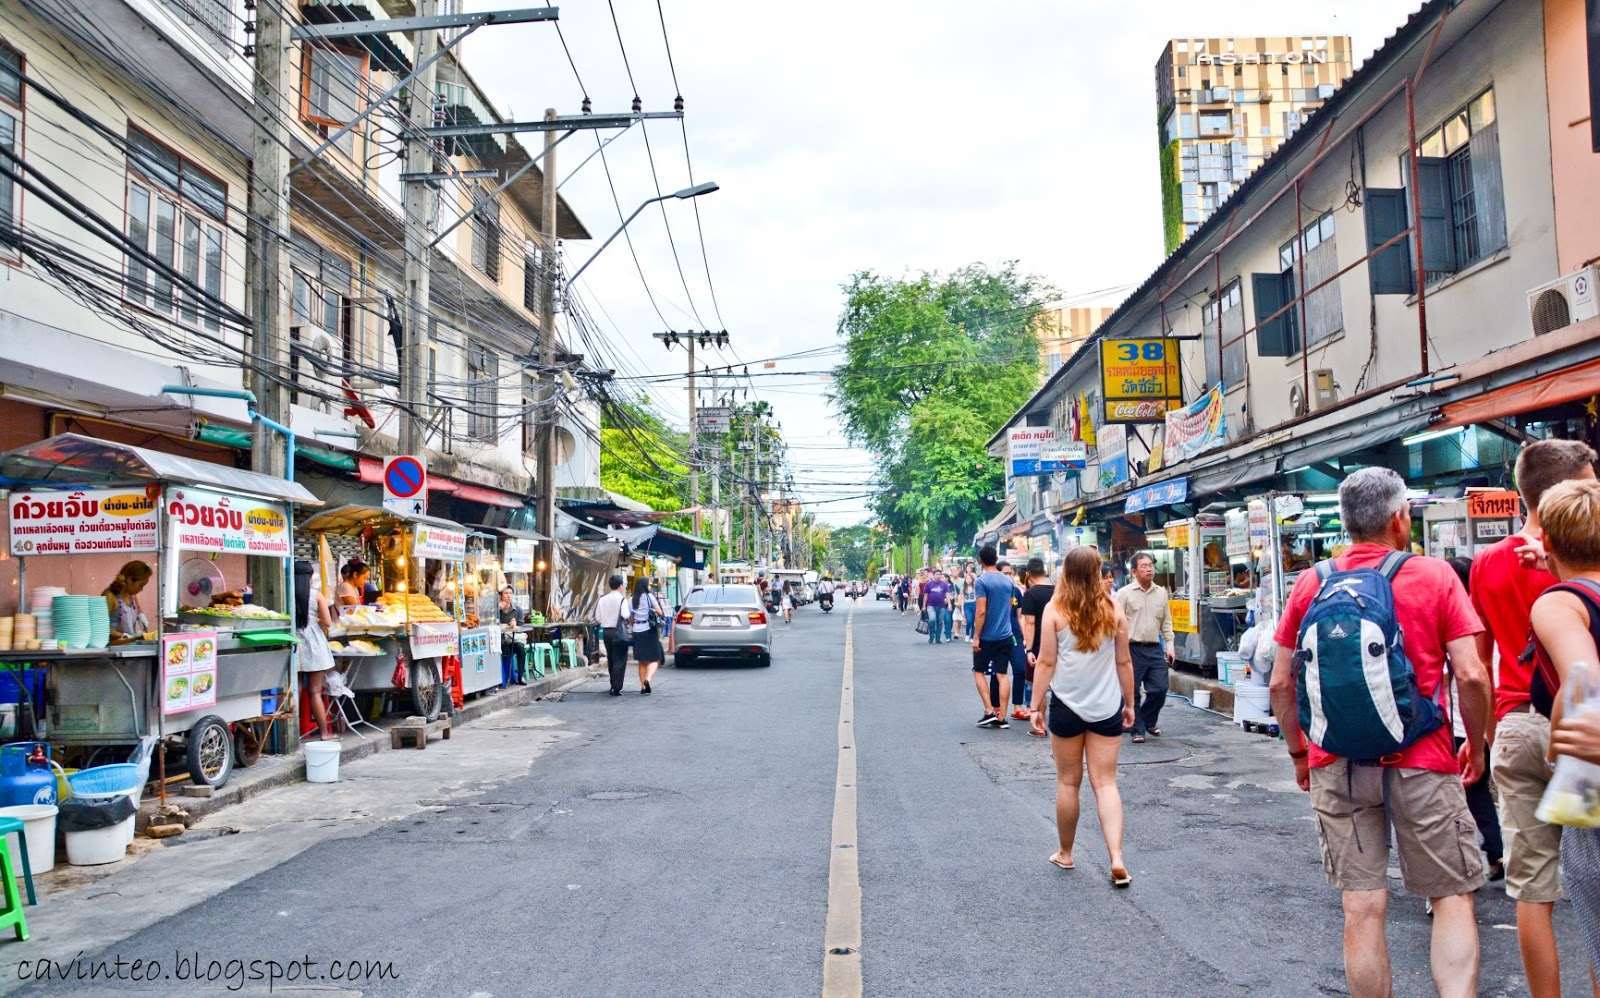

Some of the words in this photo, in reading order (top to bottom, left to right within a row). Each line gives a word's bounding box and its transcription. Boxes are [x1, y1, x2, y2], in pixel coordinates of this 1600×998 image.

[1197, 51, 1327, 65] ASHTON
[1118, 342, 1163, 361] 38
[13, 491, 98, 520] ก๋วยจั๊บ
[1471, 494, 1515, 516] โจ๊กหมู
[14, 540, 33, 552] 40
